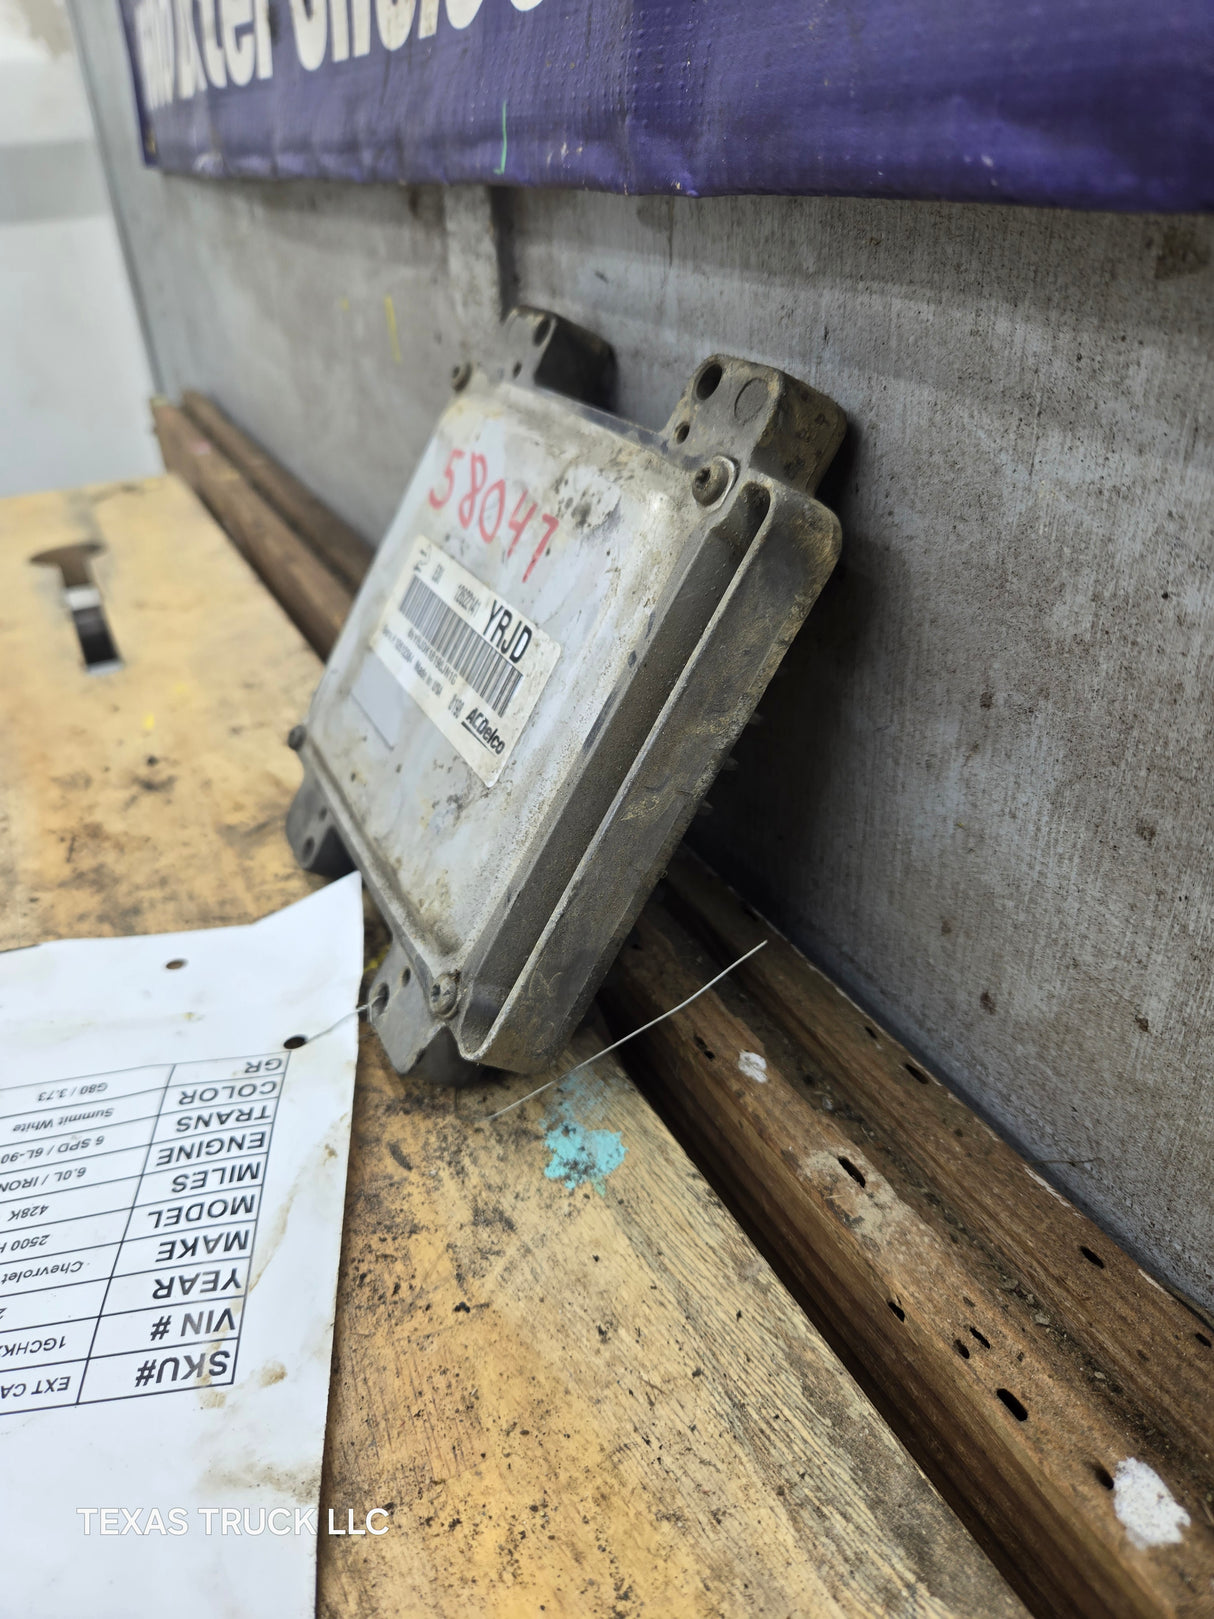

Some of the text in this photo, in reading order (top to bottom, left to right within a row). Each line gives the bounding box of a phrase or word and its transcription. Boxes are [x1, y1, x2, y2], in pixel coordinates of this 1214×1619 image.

[428, 448, 560, 584] 58047
[482, 599, 533, 664] YRJD
[465, 707, 506, 756] ACDelco
[244, 1056, 284, 1075] GR
[37, 1088, 67, 1102] 3.73
[79, 1081, 108, 1094] G80
[178, 1079, 278, 1106] COLOR
[12, 1107, 115, 1133] Summit White
[176, 1104, 272, 1133] TRANS
[57, 1138, 92, 1153] SPD
[95, 1135, 105, 1146] 6
[155, 1130, 267, 1167] ENGINE
[0, 1147, 45, 1165] 6L-90
[0, 1175, 40, 1193] IRON
[53, 1166, 87, 1183] 6.0L
[171, 1160, 262, 1194] MILES
[7, 1203, 50, 1222] 428K
[147, 1193, 256, 1229] MODEL
[10, 1233, 51, 1252] 2500
[154, 1229, 250, 1263] MAKE
[1, 1260, 85, 1285] Chevrolet
[151, 1267, 243, 1300] YEAR
[150, 1307, 236, 1341] VIN #
[0, 1335, 67, 1358] 1GCHK
[134, 1350, 231, 1388] SKU#
[30, 1375, 71, 1395] EXT
